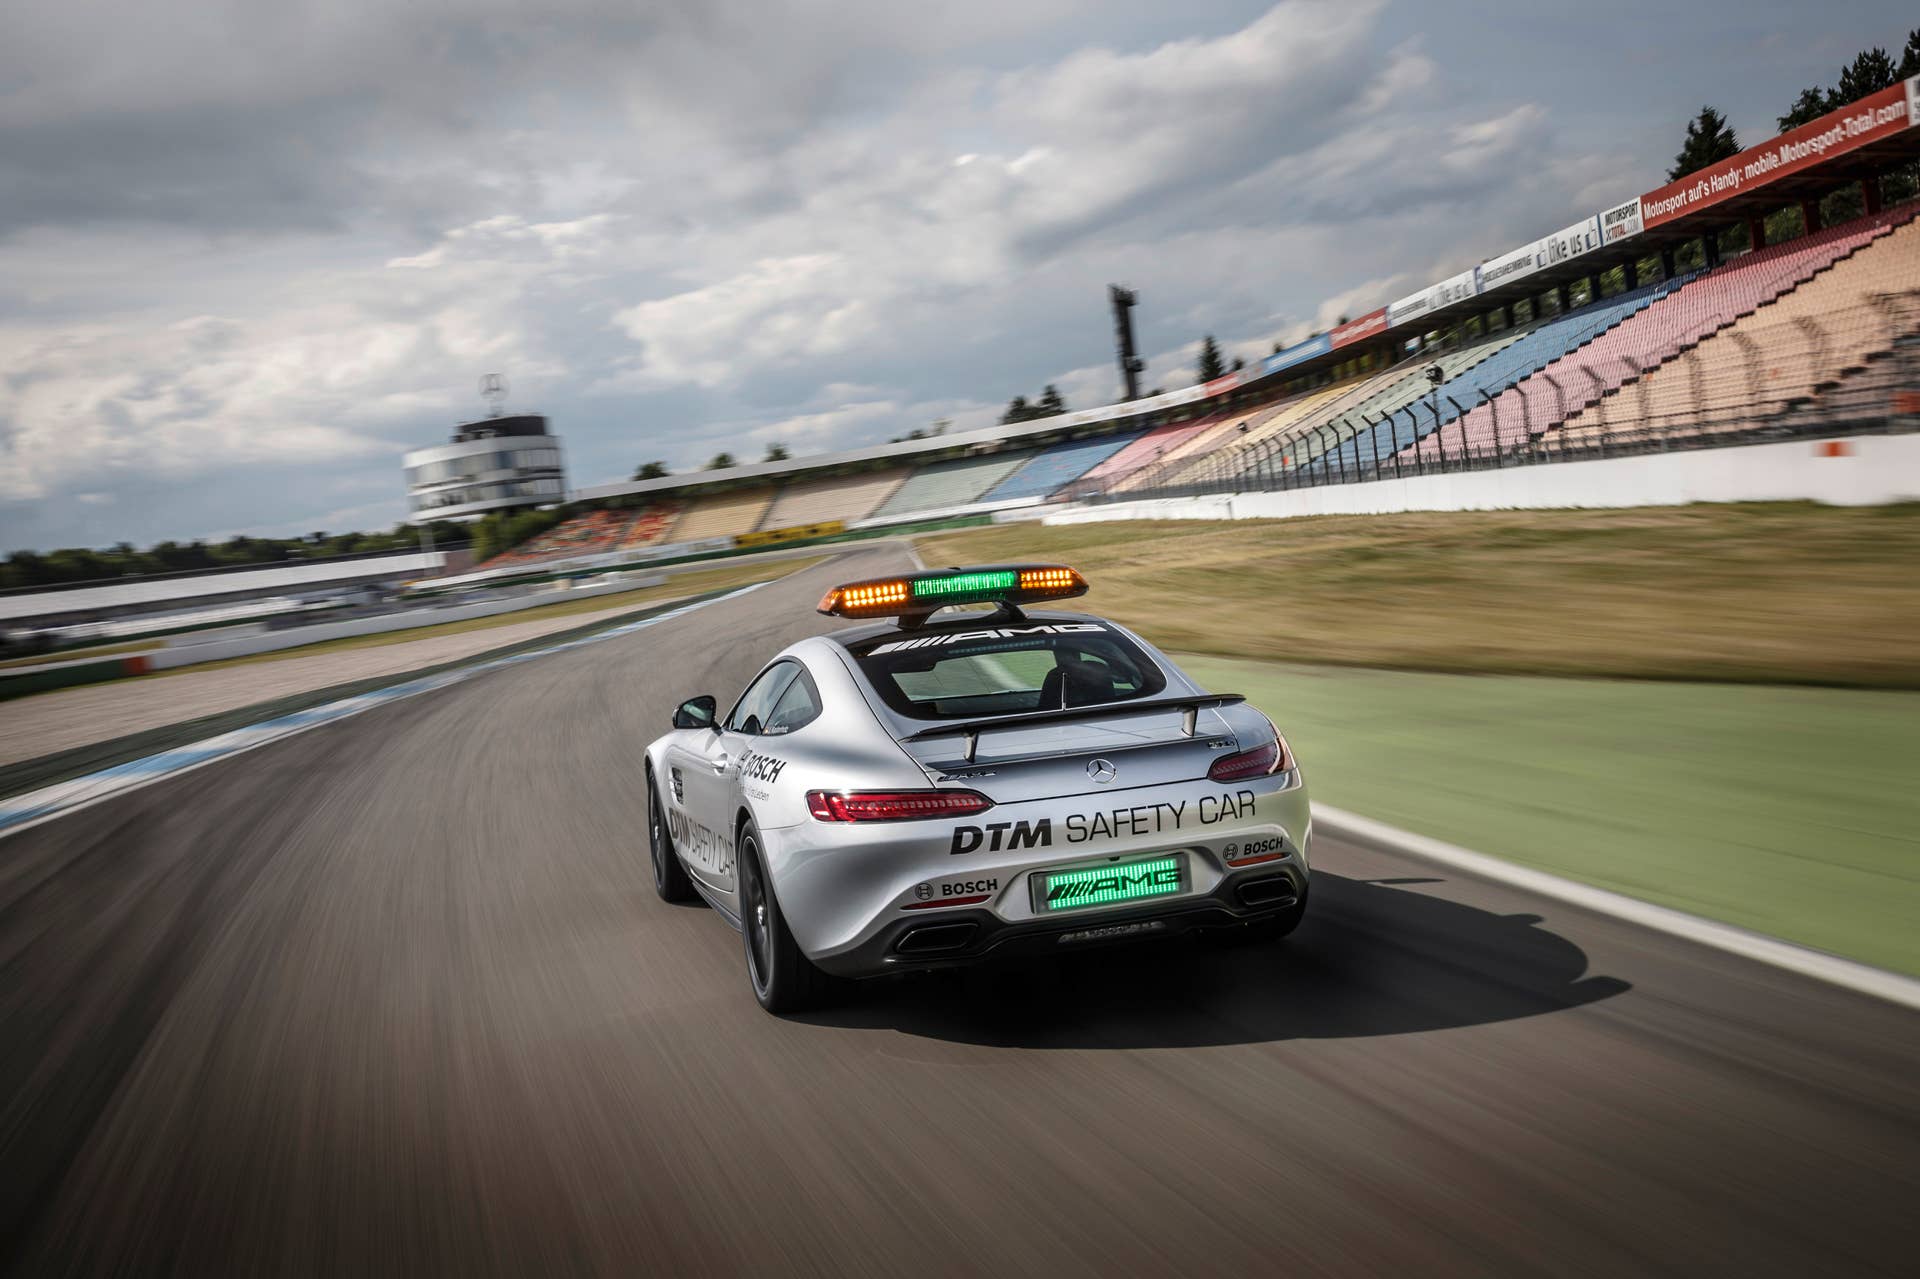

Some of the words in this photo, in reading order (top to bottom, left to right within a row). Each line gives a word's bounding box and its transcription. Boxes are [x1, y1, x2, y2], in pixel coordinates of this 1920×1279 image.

[1643, 192, 1688, 220] Motorsport
[1710, 168, 1744, 193] Handy:
[1605, 201, 1638, 226] MOTORSPORT
[1548, 236, 1568, 264] like
[1570, 234, 1582, 255] us
[743, 754, 787, 783] BOSCH
[950, 818, 1053, 855] DTM
[1066, 800, 1185, 843] SAFETY
[1199, 790, 1255, 825] CAR
[669, 807, 690, 849] DTM
[689, 818, 716, 868] SAFETY
[1243, 837, 1283, 856] BOSCH
[942, 878, 998, 896] BOSCH
[1086, 868, 1181, 894] AMG
